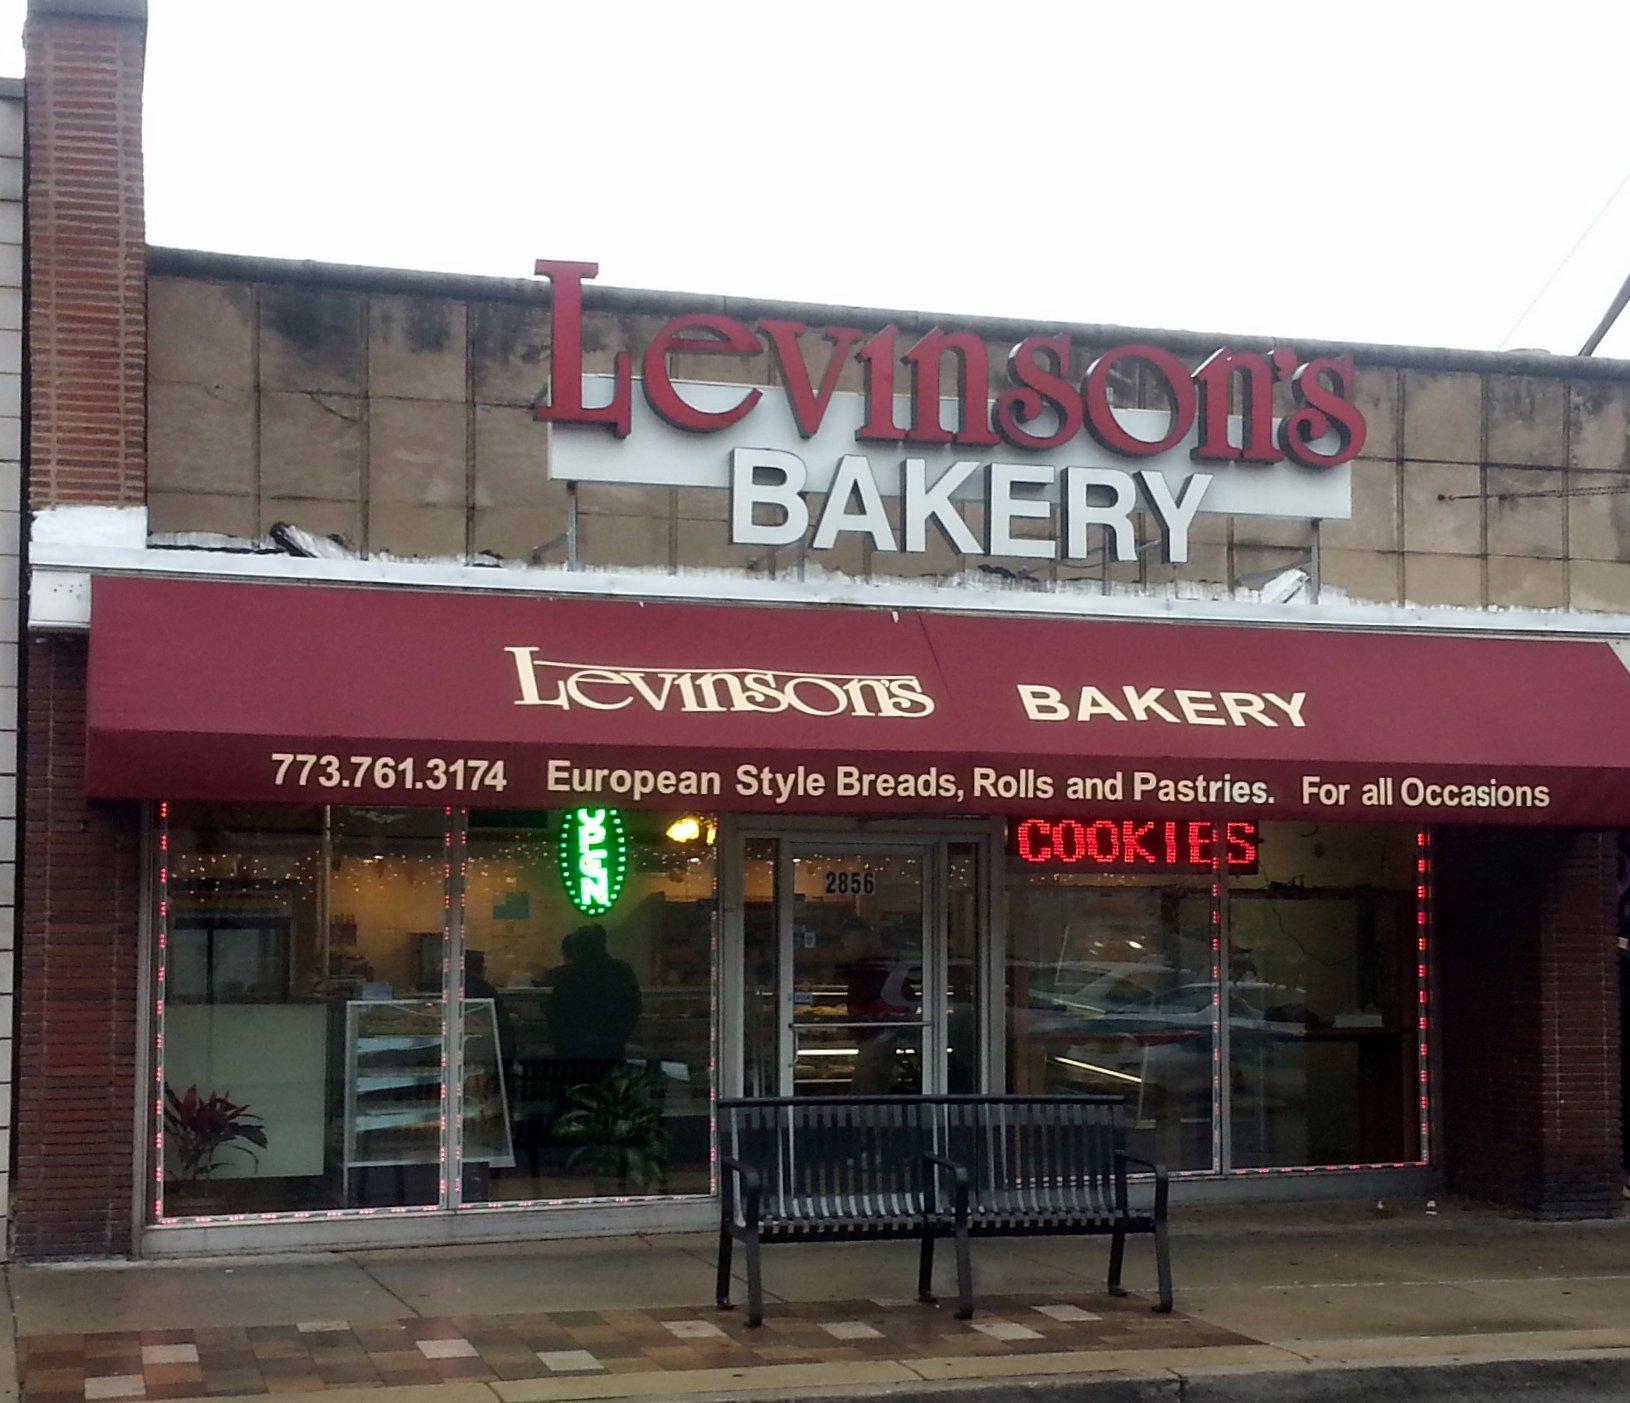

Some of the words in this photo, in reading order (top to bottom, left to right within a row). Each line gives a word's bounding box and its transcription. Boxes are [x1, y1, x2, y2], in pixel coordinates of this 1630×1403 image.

[536, 259, 1365, 468] Levinson's
[731, 448, 1213, 563] BAKERY
[1017, 684, 1307, 728] BAKERY
[272, 753, 507, 791] 773.761.3174
[547, 760, 721, 797] European
[736, 765, 826, 803] Style
[837, 766, 964, 802] Breads,
[974, 768, 1054, 799] Rolls
[1066, 772, 1123, 800] and
[1133, 772, 1275, 804] Pastries.
[1302, 776, 1351, 805] For
[1361, 778, 1393, 805] all
[1401, 777, 1550, 807] Occasions
[1018, 819, 1255, 864] COOKIES
[825, 871, 875, 894] 2856
